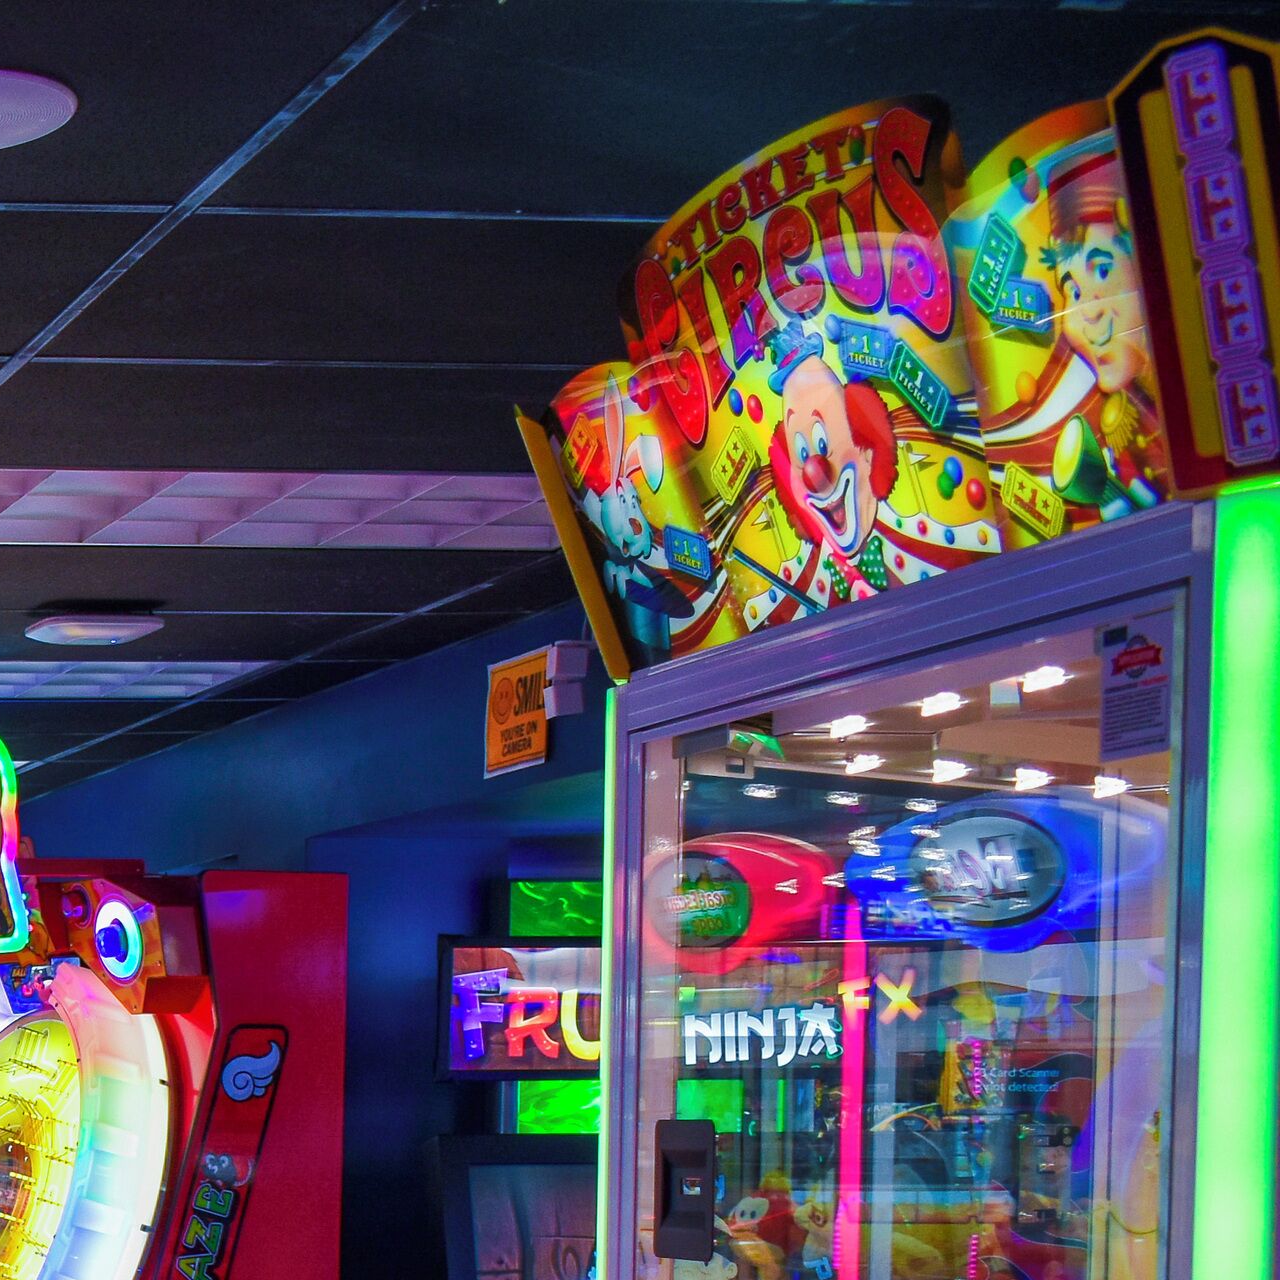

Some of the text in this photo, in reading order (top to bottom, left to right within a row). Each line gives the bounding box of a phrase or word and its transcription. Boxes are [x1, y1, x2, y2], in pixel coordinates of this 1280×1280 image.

[669, 128, 858, 264] TICKET
[635, 106, 952, 445] CIRCUS
[987, 243, 1009, 296] TICKET
[1012, 289, 1021, 307] 1
[999, 307, 1036, 321] TICKET
[861, 335, 871, 353] 1
[848, 353, 885, 369] TICKET
[914, 371, 925, 388] 1
[898, 372, 934, 413] TICKET
[682, 540, 690, 555] 1
[673, 553, 703, 569] TICKET
[514, 670, 549, 716] SMIL
[526, 720, 538, 735] ON
[502, 736, 532, 757] CAMERA
[451, 967, 924, 1068] FRU NINJA FX
